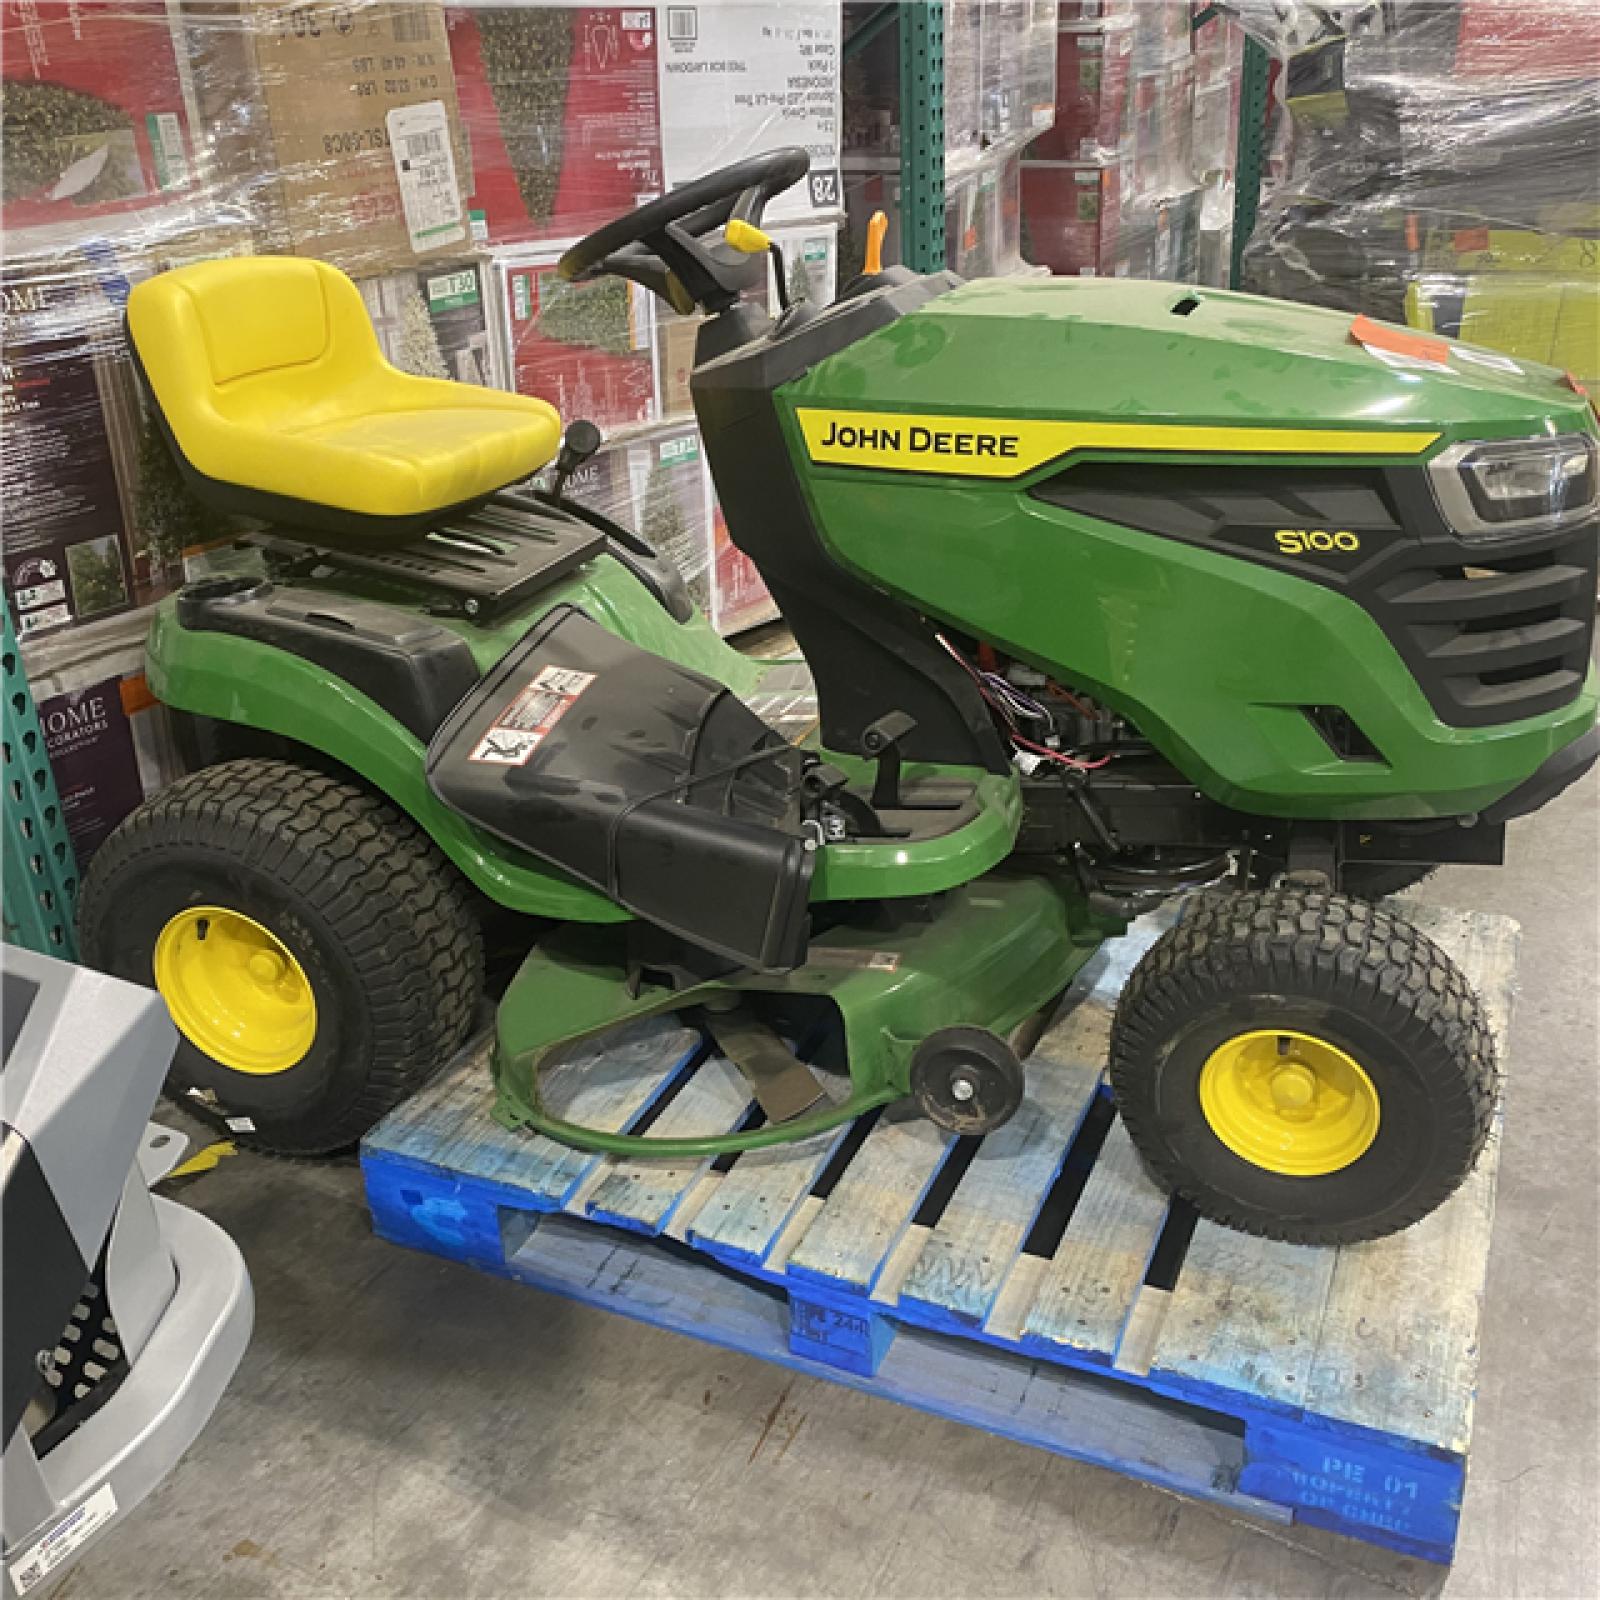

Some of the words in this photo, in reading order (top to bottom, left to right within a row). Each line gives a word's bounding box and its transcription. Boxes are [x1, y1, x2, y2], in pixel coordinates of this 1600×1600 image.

[820, 421, 901, 451] JOHN
[909, 426, 1019, 457] DEERE
[1274, 529, 1361, 554] S100
